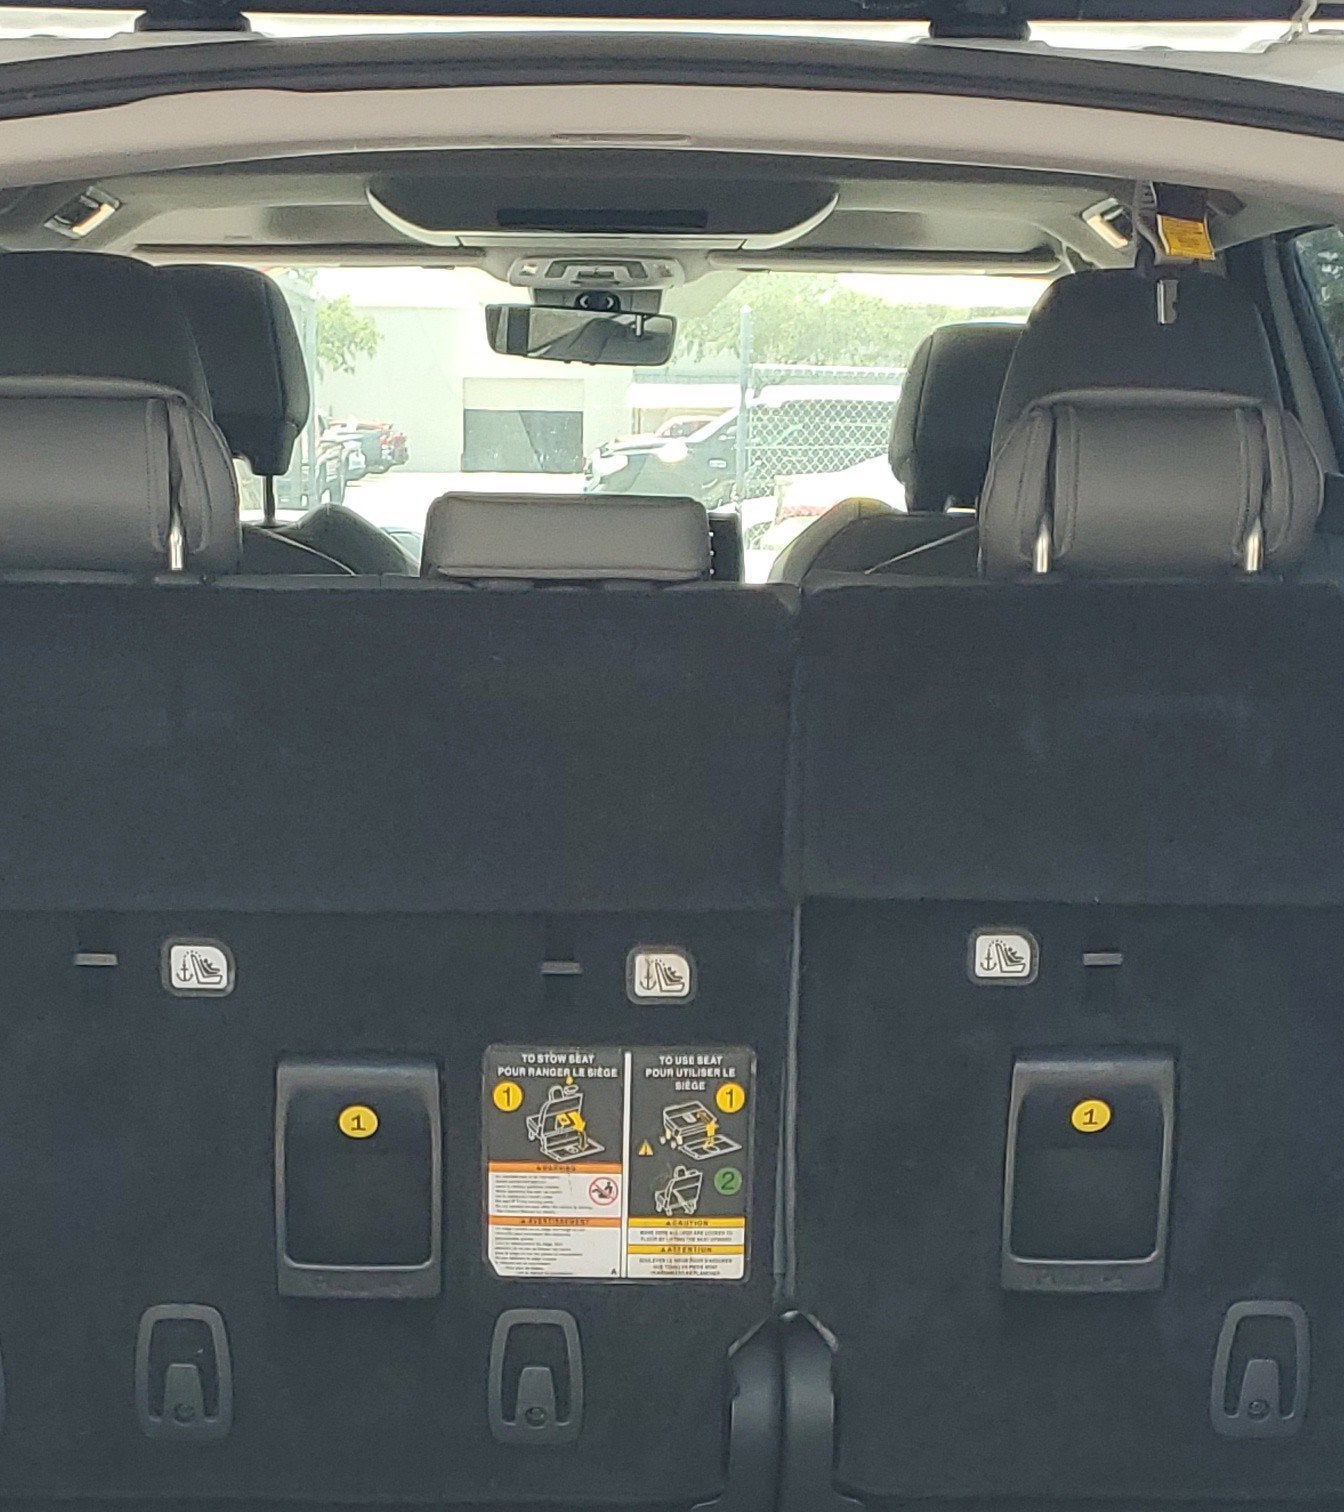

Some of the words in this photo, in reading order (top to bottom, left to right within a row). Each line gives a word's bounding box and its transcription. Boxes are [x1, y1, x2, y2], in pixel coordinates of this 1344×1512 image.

[521, 1053, 536, 1064] TO
[537, 1053, 567, 1064] STOW
[568, 1054, 596, 1065] SEAT
[659, 1055, 673, 1066] TO
[675, 1055, 695, 1066] USE
[696, 1055, 723, 1066] SEAT
[497, 1066, 526, 1077] POUR
[527, 1066, 571, 1077] RANGER
[572, 1067, 586, 1078] LE
[645, 1067, 674, 1078] POUR
[675, 1067, 721, 1078] UTILISER
[722, 1067, 736, 1078] LE
[350, 1114, 367, 1132] 1
[1082, 1108, 1098, 1126] 1
[721, 1171, 735, 1190] 2
